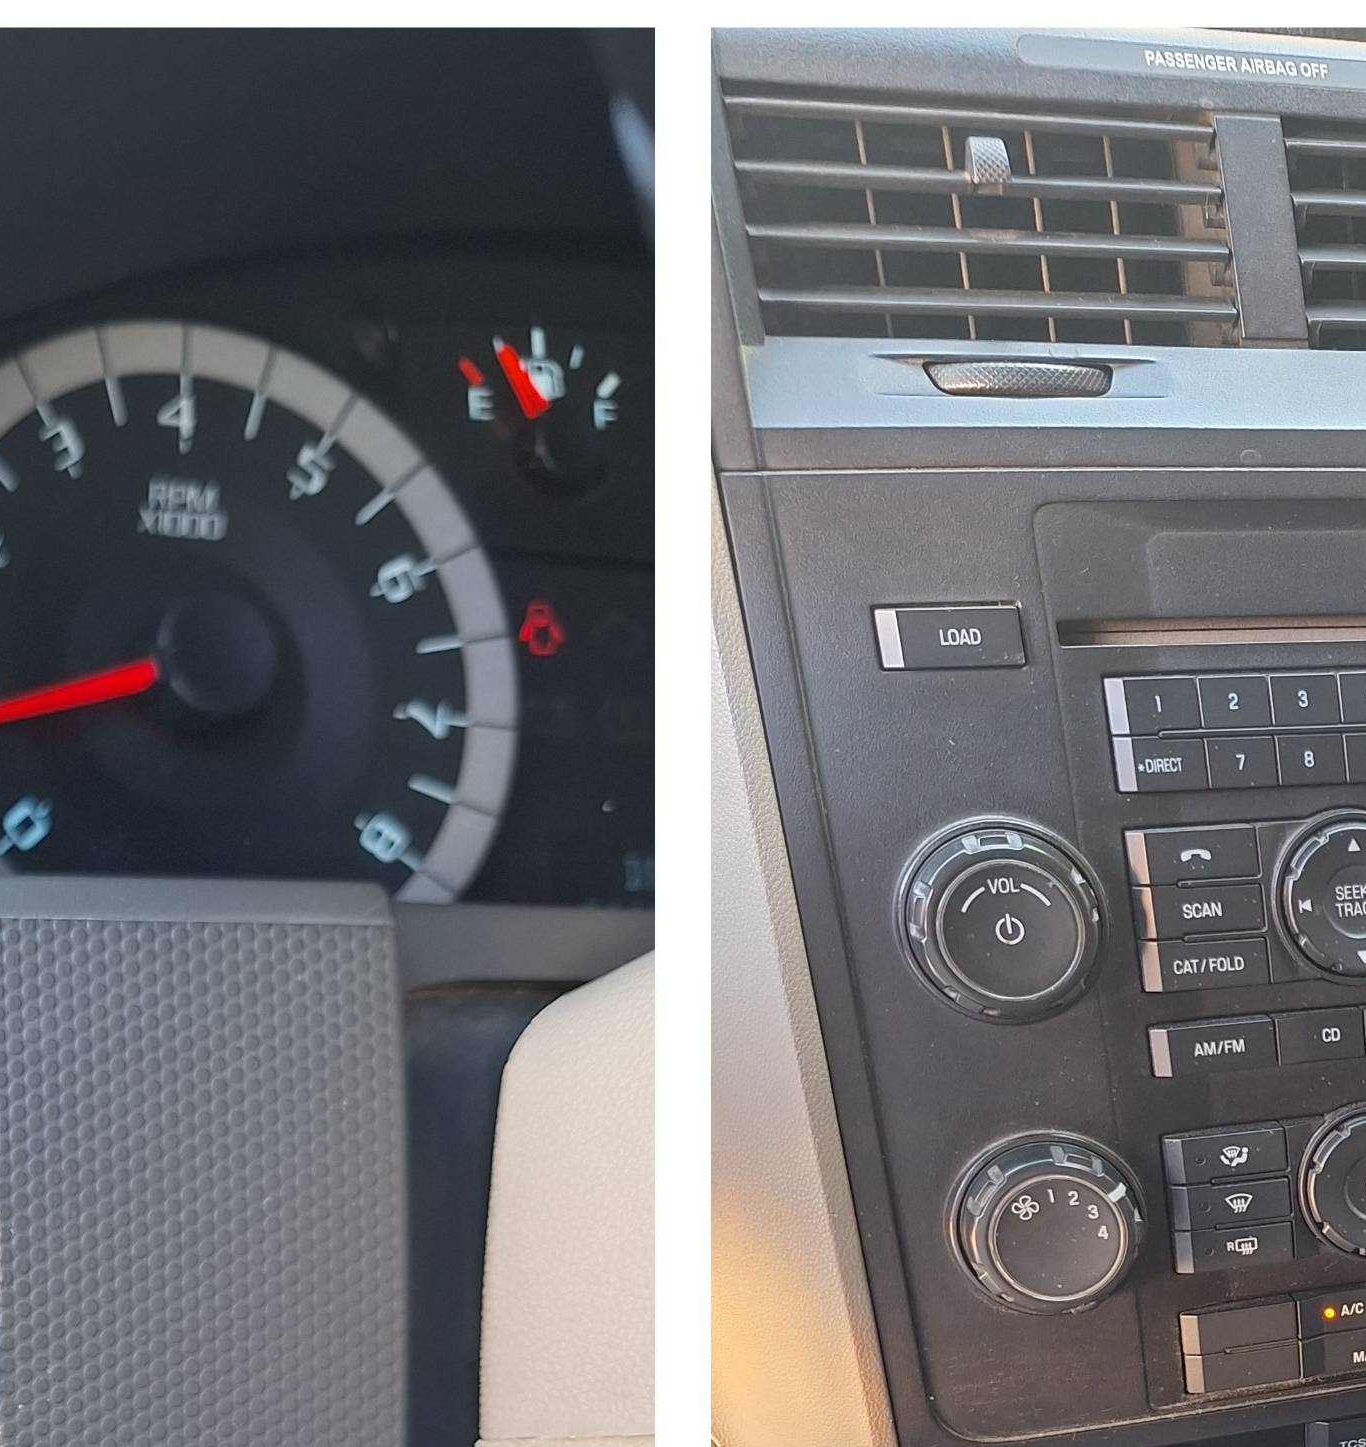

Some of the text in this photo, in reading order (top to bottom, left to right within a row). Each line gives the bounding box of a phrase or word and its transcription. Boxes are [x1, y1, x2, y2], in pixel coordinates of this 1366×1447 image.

[1144, 49, 1328, 79] PASSENGER AIRBAG OFF
[468, 386, 495, 420] E
[157, 395, 195, 442] 4
[593, 400, 619, 431] F
[39, 416, 84, 472] 3
[287, 440, 333, 496] 5
[148, 475, 220, 510] RPM
[939, 628, 981, 646] LOAD
[1155, 695, 1162, 713] 1
[1228, 693, 1239, 710] 2
[1298, 690, 1309, 708] 3
[1236, 755, 1245, 771] 7
[1304, 751, 1315, 768] 8
[987, 877, 1020, 896] VOL
[1182, 902, 1223, 919] SCAN
[1322, 1027, 1341, 1043] CD
[1194, 1039, 1245, 1057] AM/FM
[1047, 1189, 1055, 1203] 1
[1067, 1191, 1079, 1206] 2
[1088, 1204, 1099, 1219] 3
[1097, 1225, 1109, 1239] 4
[1341, 1302, 1364, 1317] A/C
